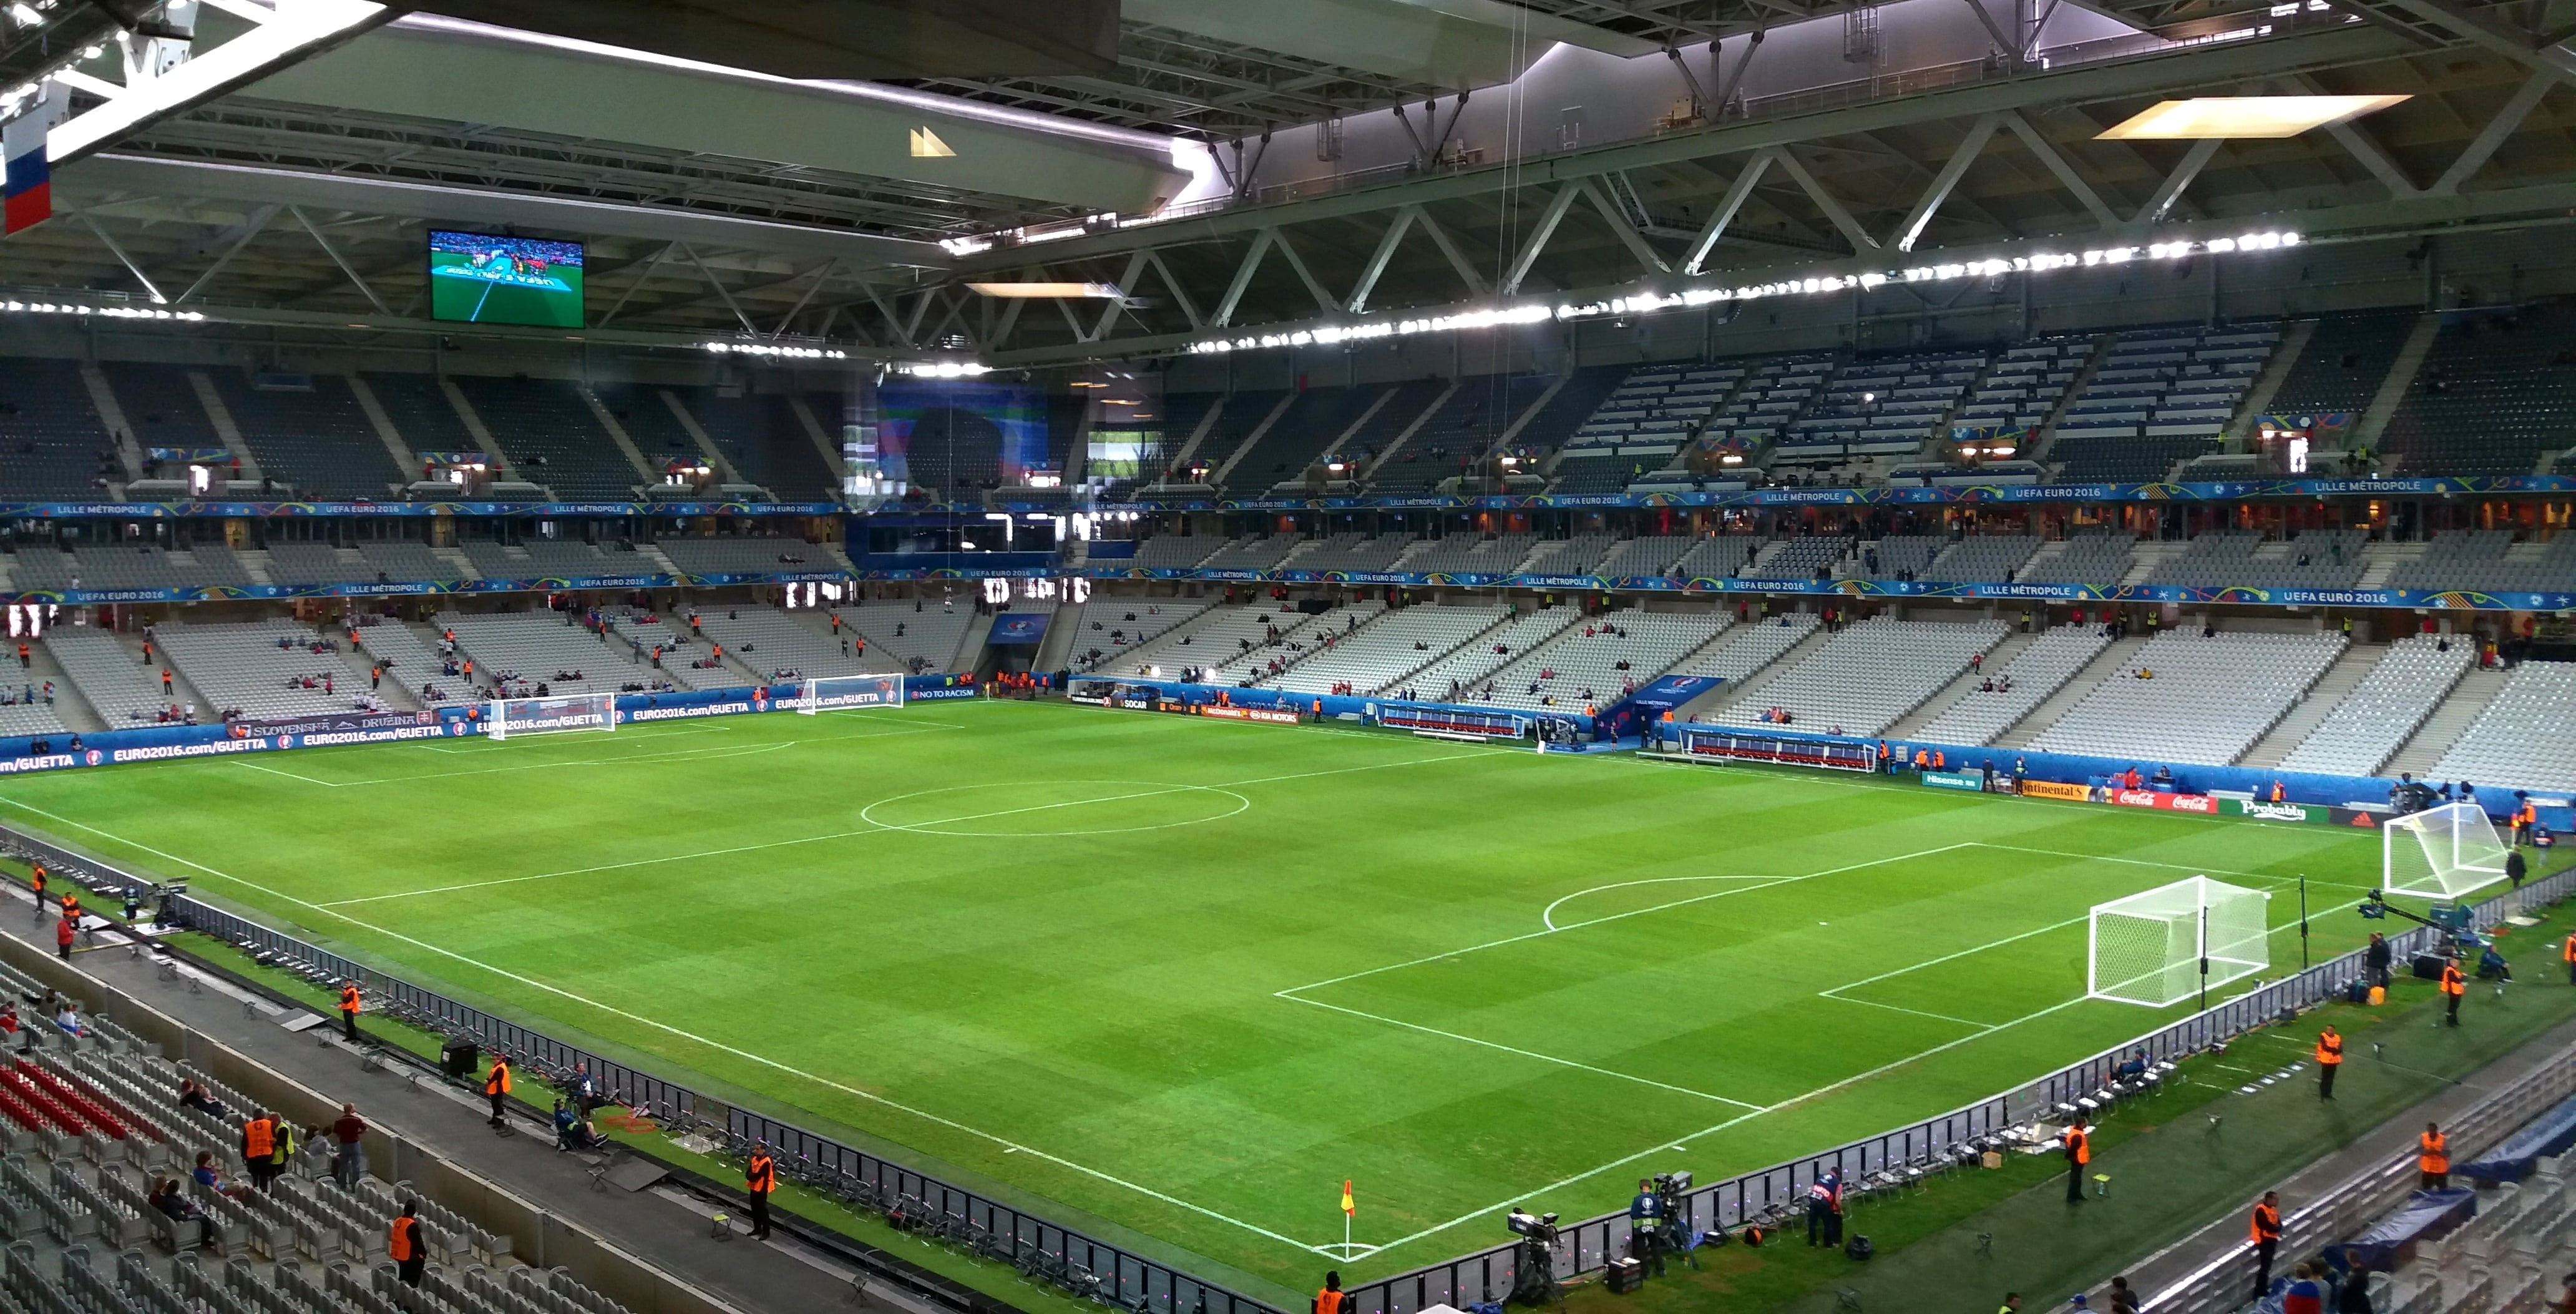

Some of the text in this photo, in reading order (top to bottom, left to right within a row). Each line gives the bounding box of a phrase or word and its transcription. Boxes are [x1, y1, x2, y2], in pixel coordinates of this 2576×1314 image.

[2315, 480, 2421, 491] LILLE MÉTROPOLE
[1790, 493, 1840, 501] MÉTROPOLE
[2016, 488, 2100, 498] UEFA EURO 2016
[57, 505, 147, 514] LILLE MÉTROPOLE
[1546, 577, 1588, 586] MÉTROPOLE
[1733, 581, 1805, 591] UEFA EURO 2016
[371, 584, 422, 592] MÉTROPOLE
[1982, 585, 2071, 596] LILLE MÉTROPOLE
[77, 592, 105, 601] UEFA
[139, 591, 165, 599] 2016
[2284, 592, 2388, 603] UEFA EURO 2016
[945, 689, 974, 697] RACISM
[775, 693, 879, 709] EURO206.com/GUETTA
[1125, 700, 1147, 709] SOCAR
[633, 703, 749, 720] EURO2016.com/GUETTA
[1208, 707, 1241, 717] McDonald's
[1272, 713, 1297, 722] MOTORS
[477, 713, 603, 733] EURO2016.com/GUETTA
[303, 726, 444, 745] EURO2016.com/GUETTA
[114, 738, 267, 761] EURO2016.com/GUETTA
[1927, 775, 1964, 785] Hisense
[2022, 782, 2074, 797] ontinental
[2240, 800, 2306, 820] Probably
